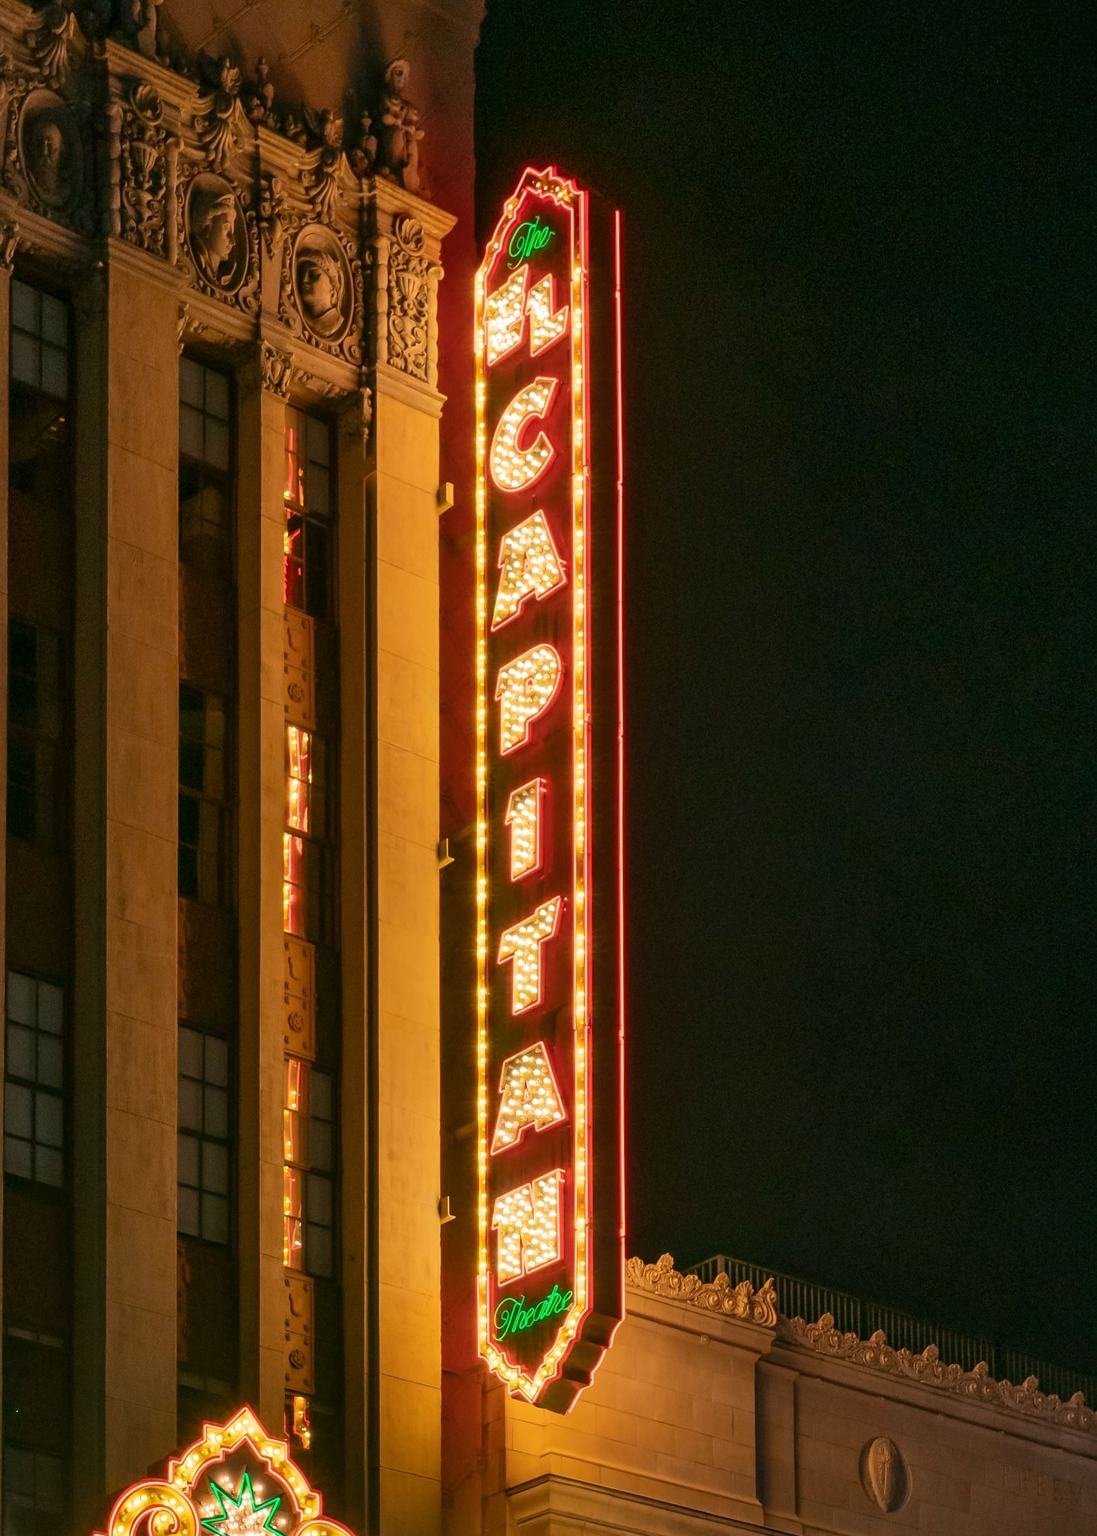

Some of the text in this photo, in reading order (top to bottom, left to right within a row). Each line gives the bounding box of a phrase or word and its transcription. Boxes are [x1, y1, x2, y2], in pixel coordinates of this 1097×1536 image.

[508, 215, 556, 270] The
[483, 263, 570, 367] EL
[489, 376, 568, 1288] CAPITAN
[493, 1284, 574, 1342] Theatre
